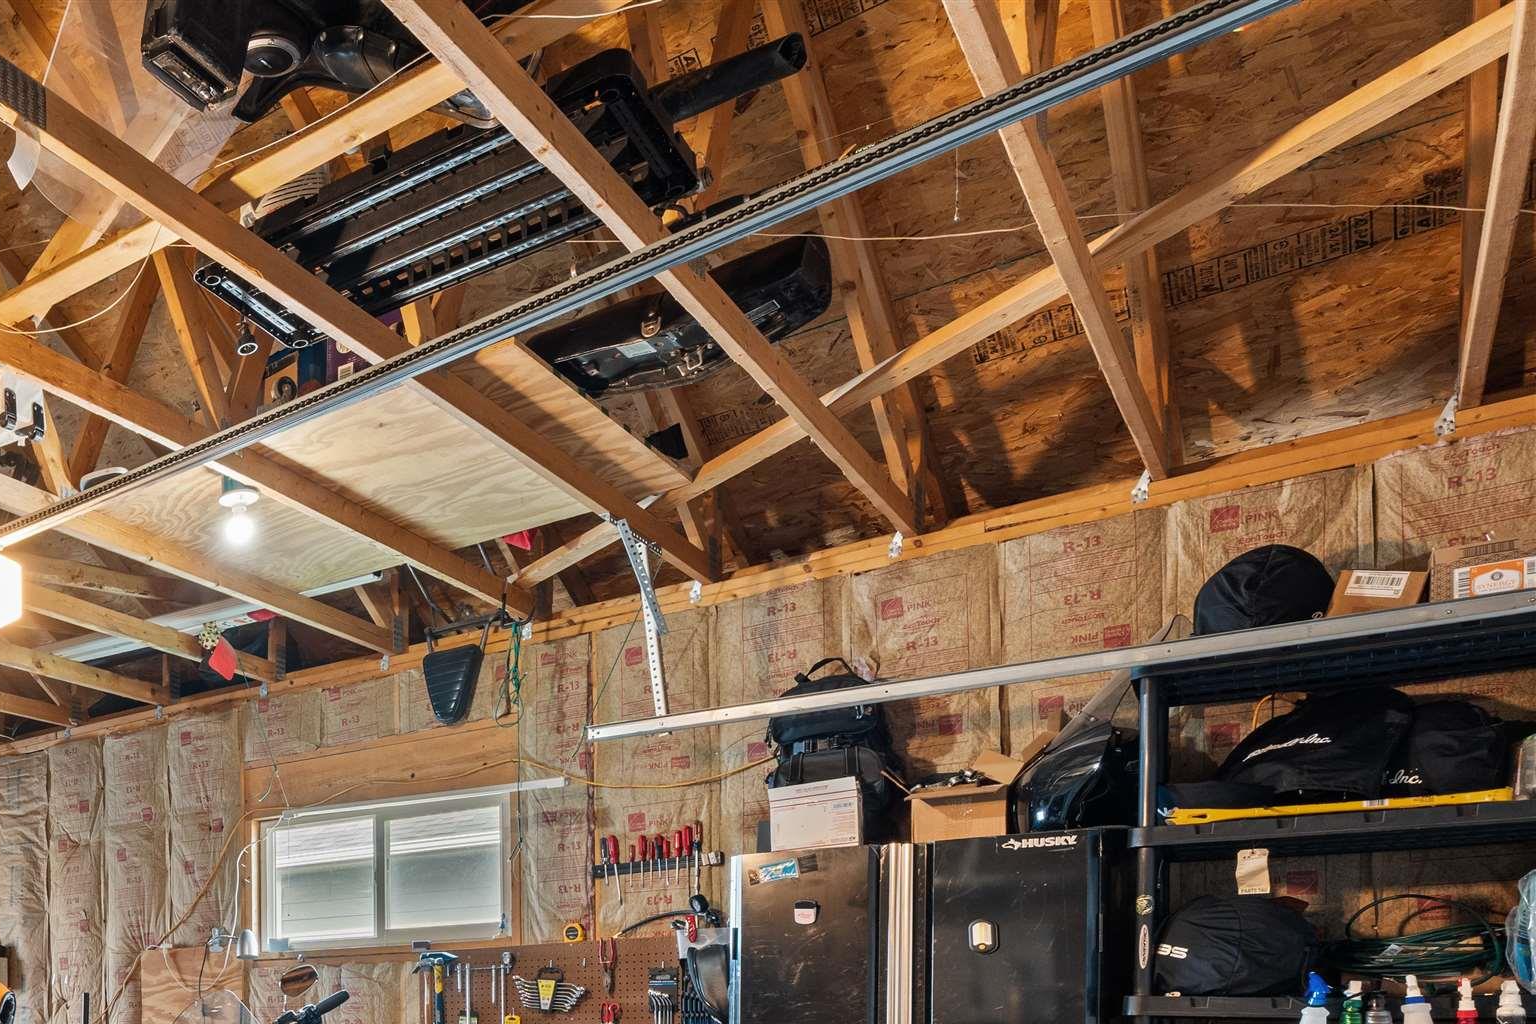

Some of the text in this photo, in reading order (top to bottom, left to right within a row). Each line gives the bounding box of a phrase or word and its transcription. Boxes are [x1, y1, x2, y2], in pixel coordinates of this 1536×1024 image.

[1448, 468, 1498, 489] R-13
[1064, 536, 1103, 552] R-13
[1064, 590, 1102, 606] R-13
[767, 602, 797, 617] R-13
[906, 600, 932, 613] PINK
[905, 636, 939, 651] R-13
[1071, 630, 1099, 644] PINK
[767, 649, 797, 664] R-13
[557, 681, 580, 693] R-13
[341, 716, 360, 727] R-13
[268, 727, 285, 738] R-13
[556, 723, 580, 735] R-13
[557, 841, 580, 852] R-13
[1021, 835, 1078, 848] HUSKY
[558, 884, 581, 894] R-13
[647, 895, 673, 906] R-13
